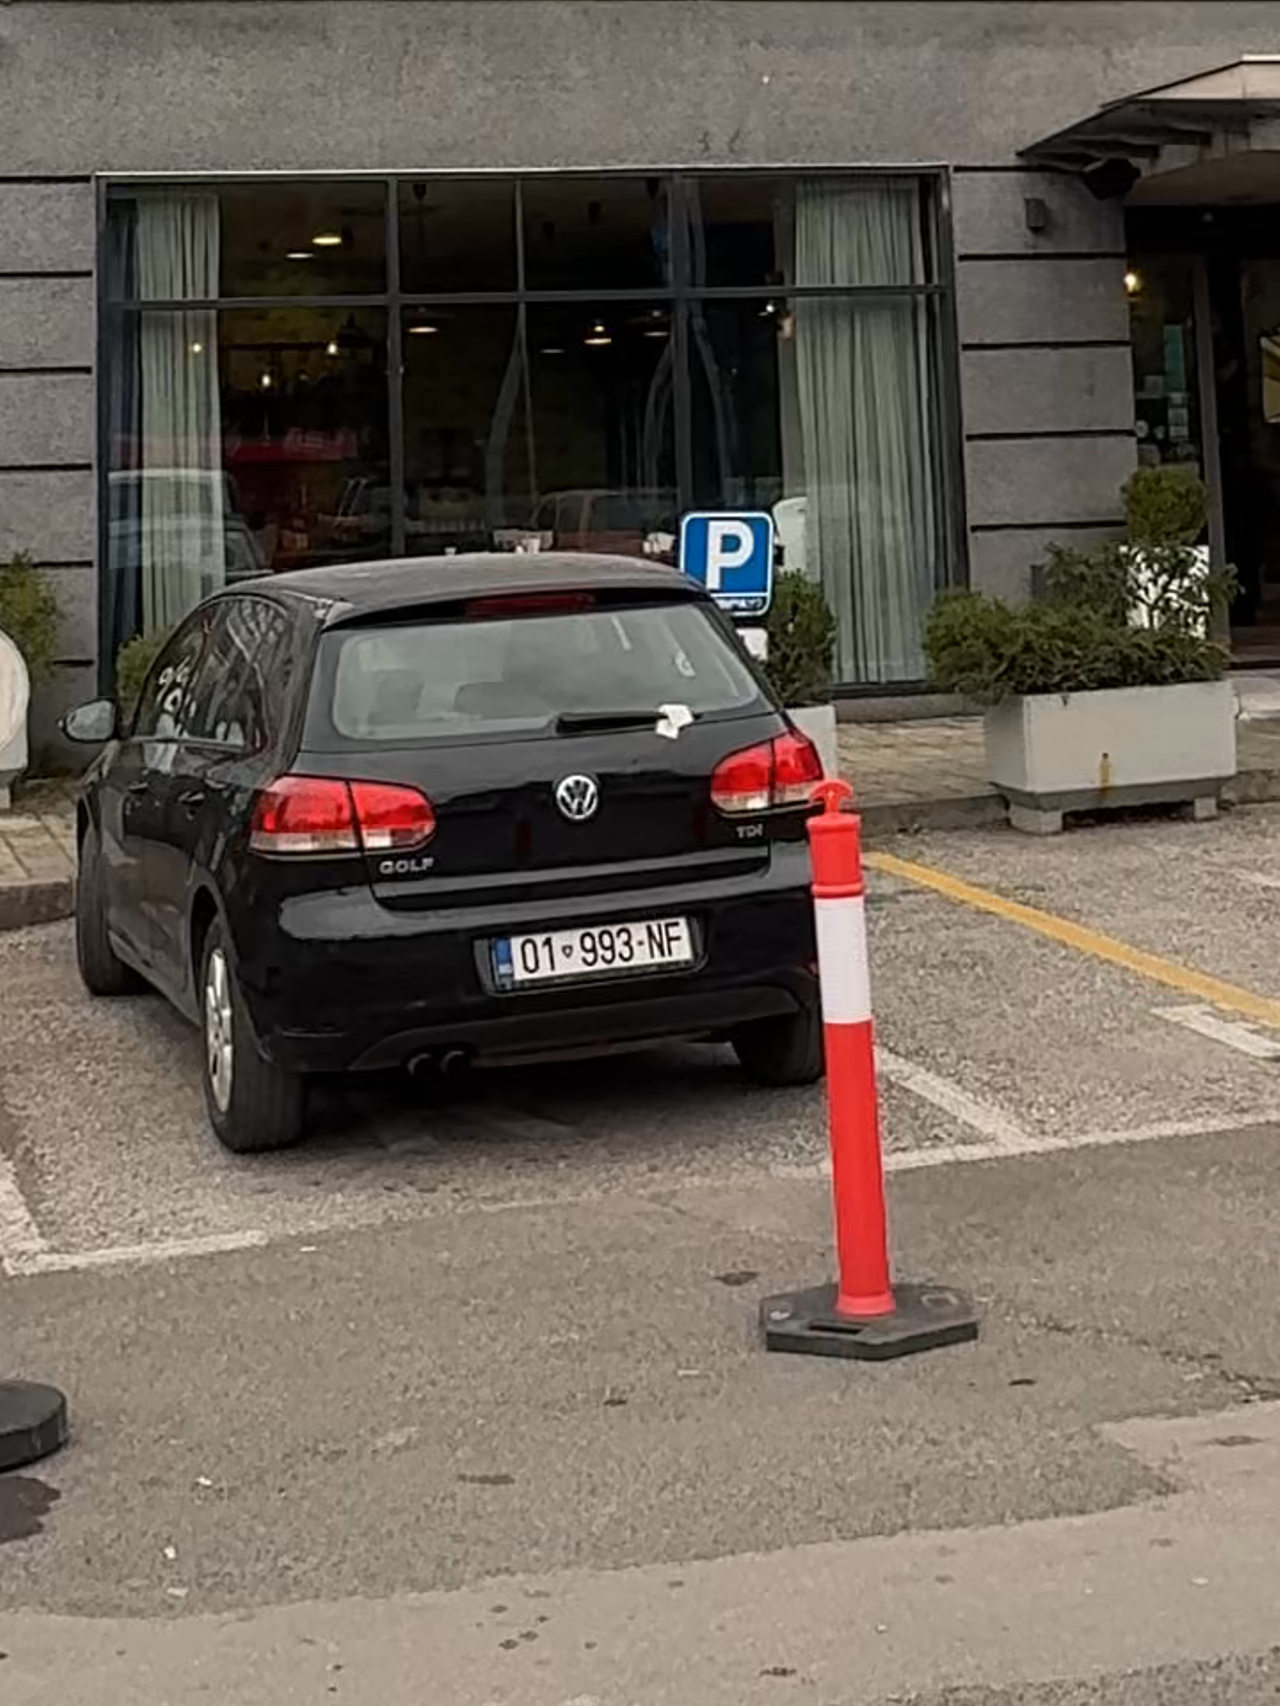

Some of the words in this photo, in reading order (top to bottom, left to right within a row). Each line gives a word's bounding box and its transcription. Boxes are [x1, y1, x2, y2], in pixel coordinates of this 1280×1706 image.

[706, 520, 754, 590] P
[379, 858, 434, 874] GOLF
[521, 937, 555, 974] 01
[579, 921, 683, 967] 993-NF
